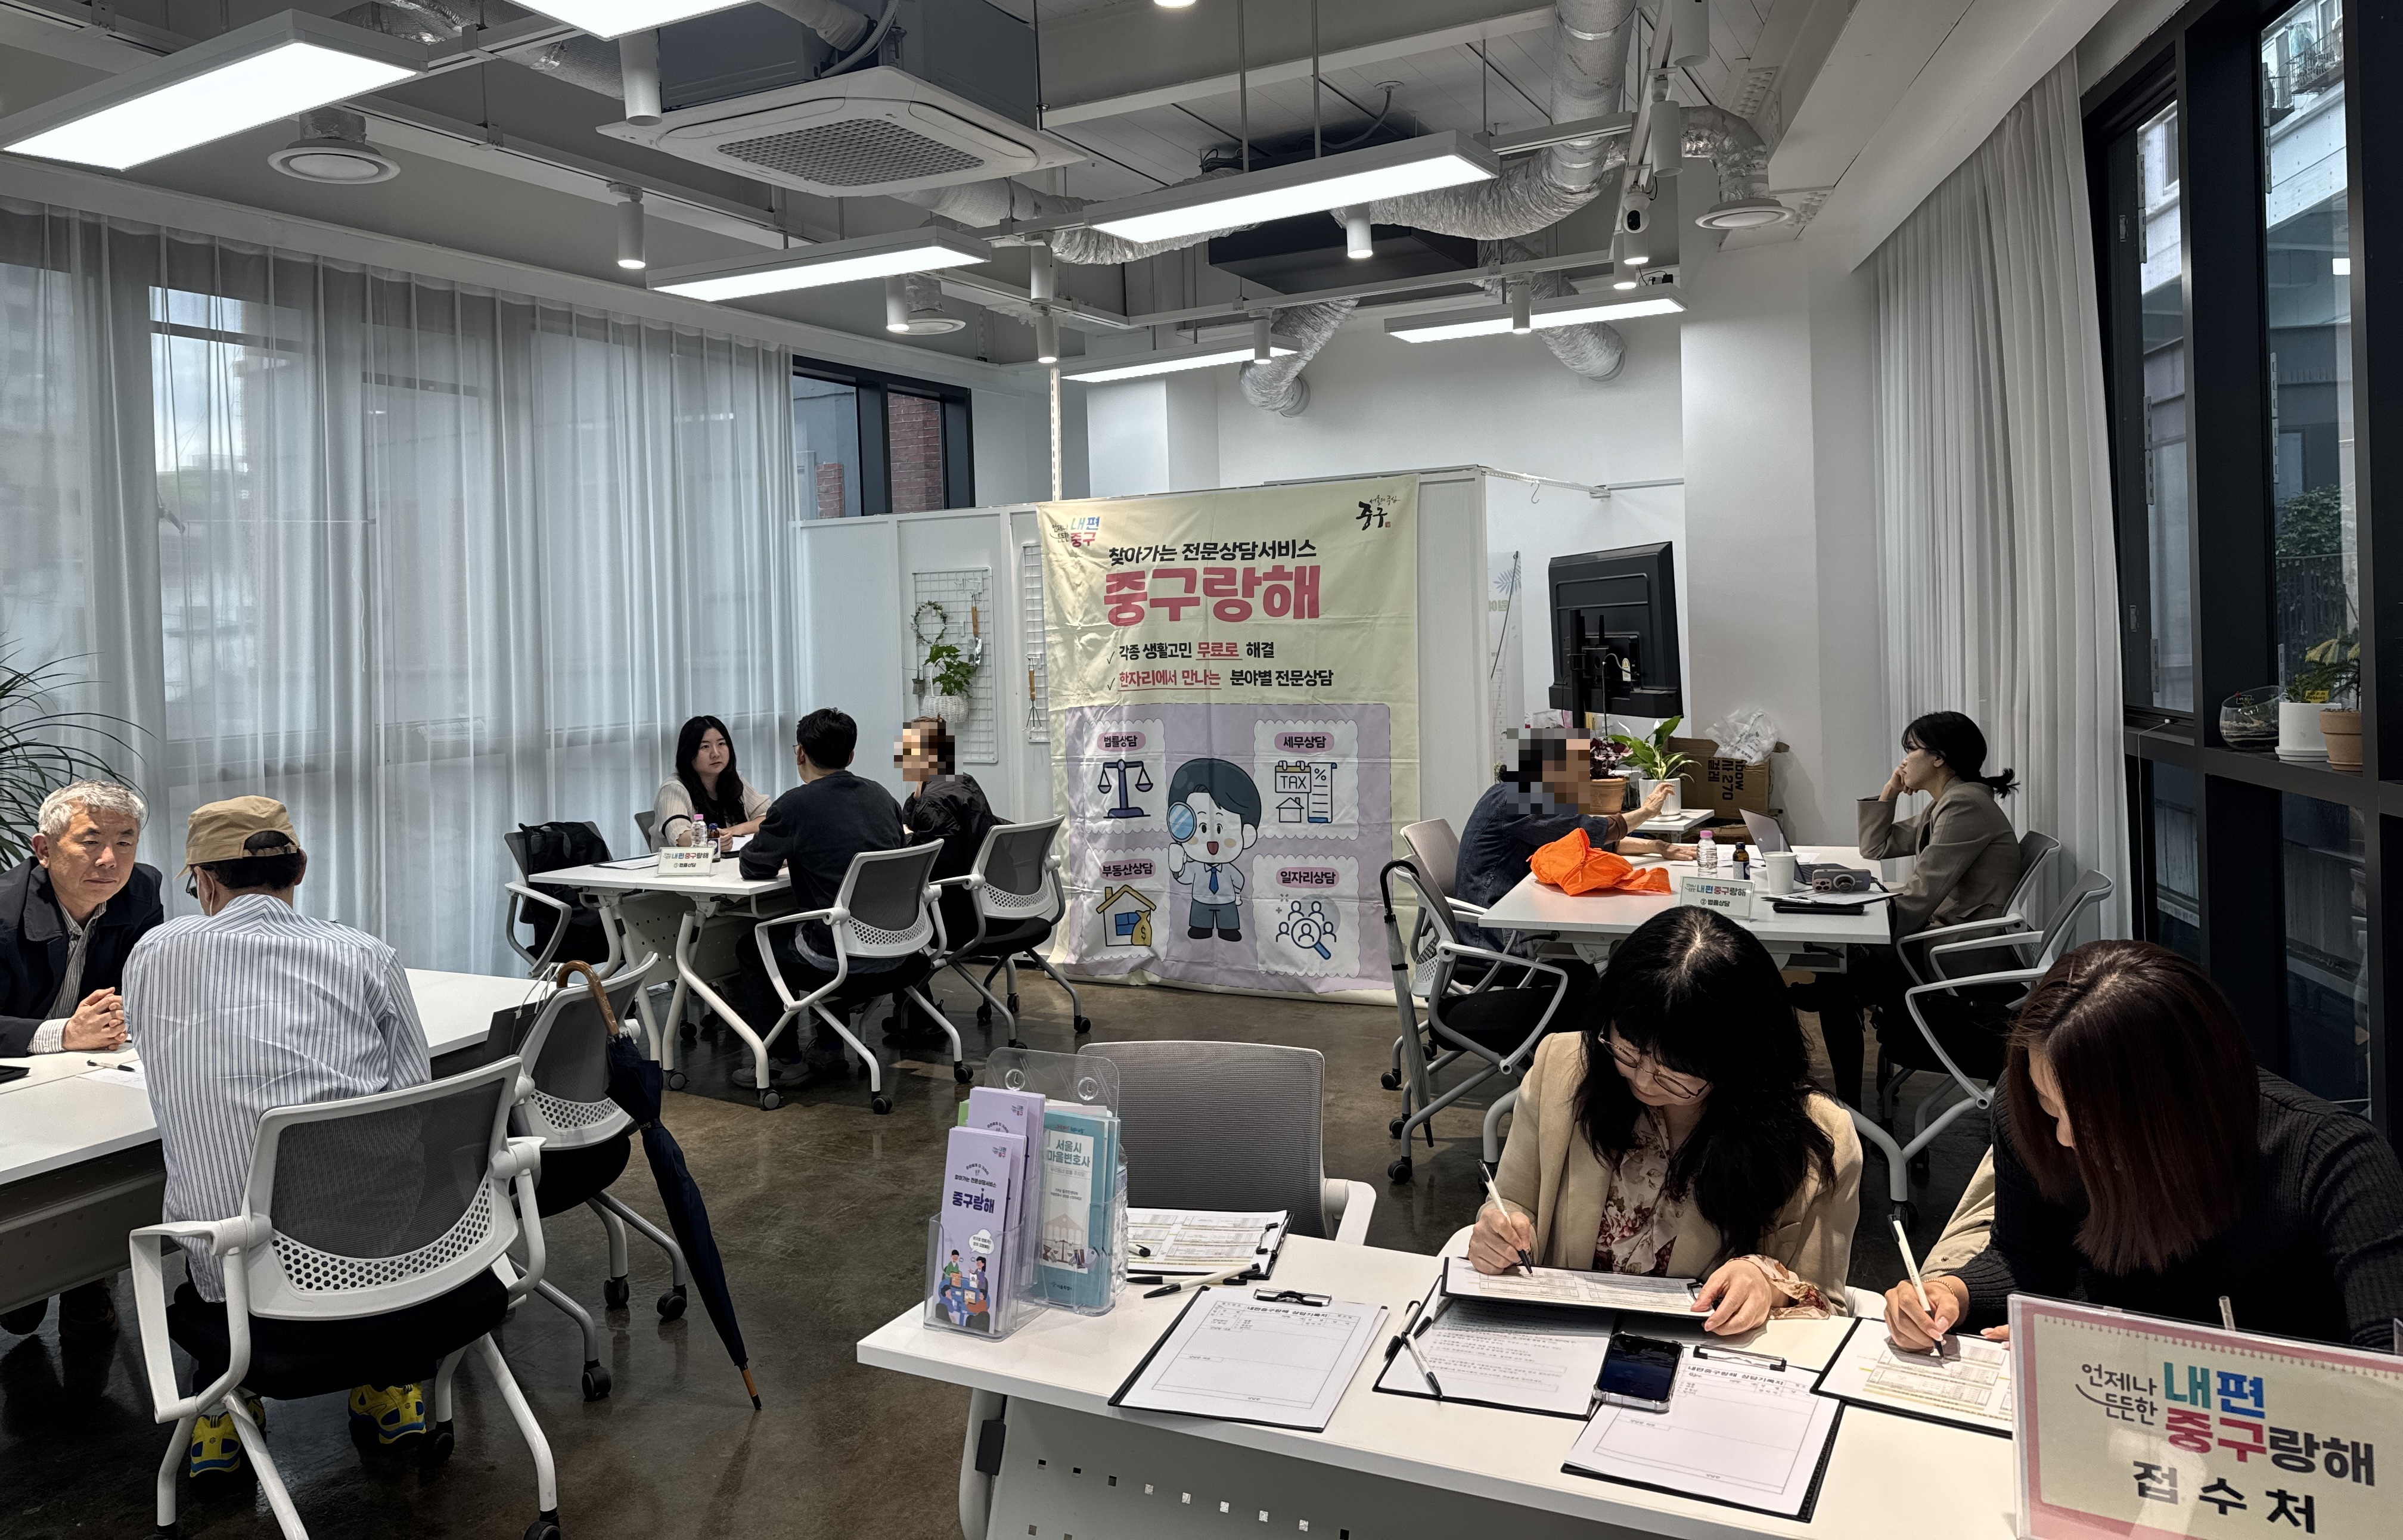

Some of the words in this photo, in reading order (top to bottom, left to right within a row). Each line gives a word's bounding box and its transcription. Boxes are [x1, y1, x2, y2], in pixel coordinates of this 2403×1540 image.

[1070, 516, 1100, 530] 내편
[1356, 501, 1388, 531] 중구
[1070, 532, 1097, 548] 중구
[1109, 545, 1178, 566] 찾아가는
[1182, 539, 1317, 562] 전문상담서비스
[1103, 564, 1322, 627] 중구랑해
[1119, 644, 1140, 660] 각종
[1142, 642, 1192, 659] 생활고민
[1197, 642, 1240, 659] 무료로
[1246, 642, 1275, 659] 해결
[1119, 670, 1178, 687] 한자리에서
[1182, 670, 1221, 687] 만나는
[1230, 669, 1273, 687] 분야별
[1275, 669, 1334, 687] 전문상담
[1103, 735, 1138, 749] 법률상담
[1283, 734, 1327, 750] 세무상담
[1280, 775, 1308, 790] TAX
[1722, 774, 1734, 801] 270
[1102, 862, 1153, 878] 부동산상담
[1280, 870, 1337, 886] 일자리상담
[1055, 1139, 1082, 1154] 서울시
[1047, 1150, 1091, 1168] 마을변호사
[952, 1191, 995, 1214] 중구랑해
[2081, 1362, 2159, 1397] 언제나
[2163, 1361, 2266, 1419] 내편
[2104, 1392, 2159, 1426] 든든한
[2165, 1407, 2376, 1488] 중구랑해
